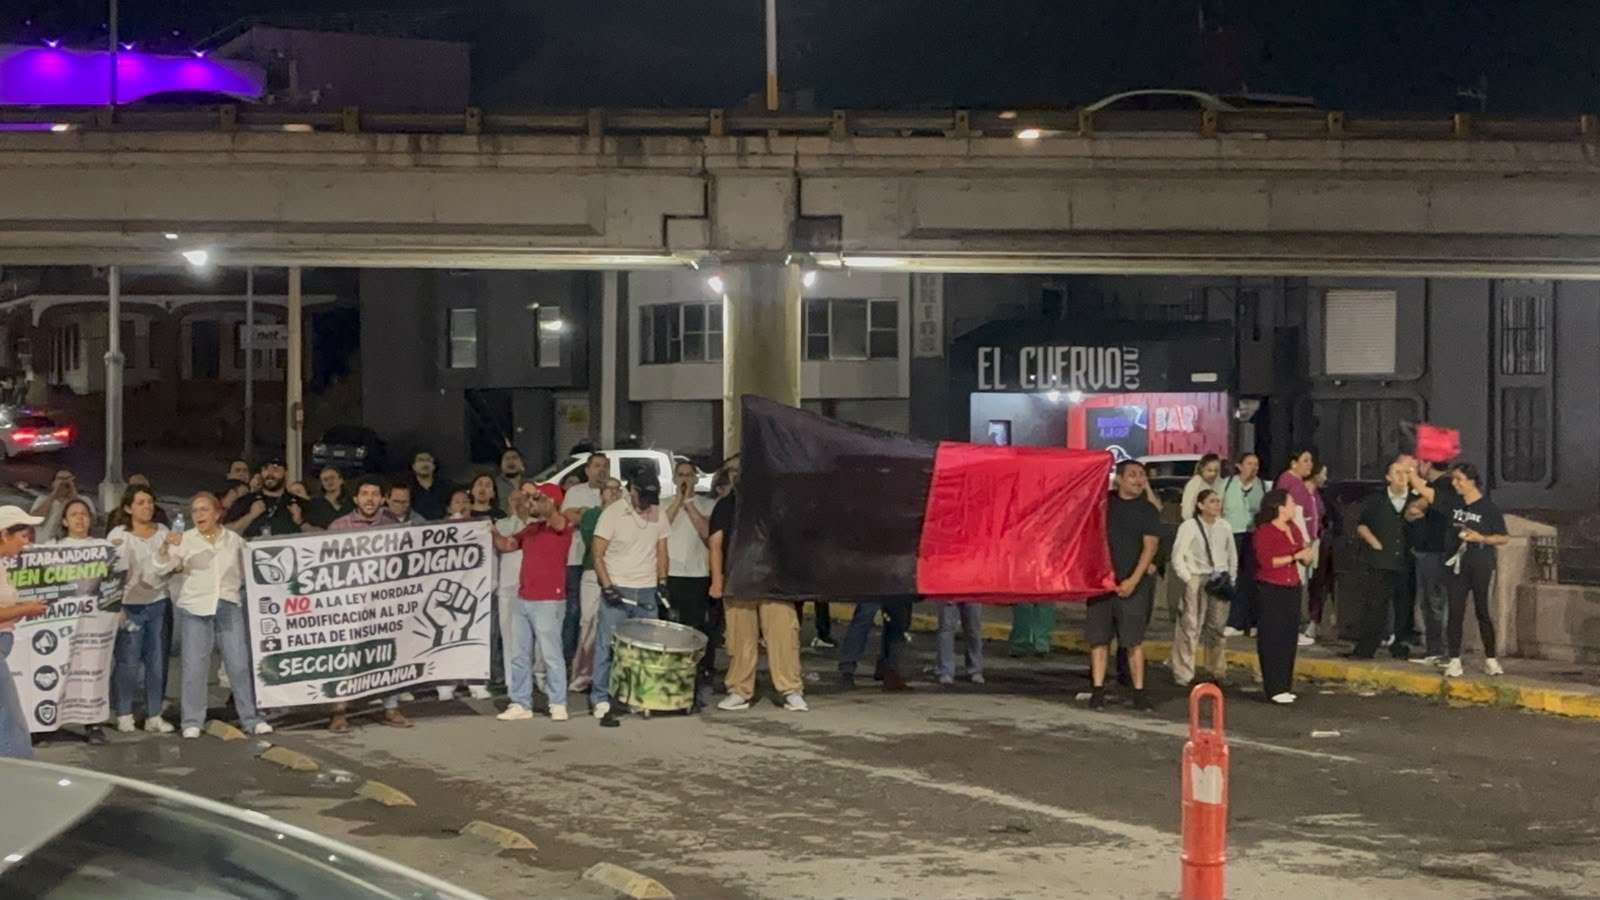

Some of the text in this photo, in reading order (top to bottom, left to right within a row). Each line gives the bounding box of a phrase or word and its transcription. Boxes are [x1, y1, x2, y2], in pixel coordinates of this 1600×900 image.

[977, 346, 1122, 390] EL CUERVO
[1155, 405, 1198, 432] BAR
[20, 546, 108, 570] TRABAJADORA
[319, 526, 458, 562] MARCHA POR
[43, 561, 108, 585] CUENTA
[297, 546, 480, 595] SALARIO DIGNO
[284, 583, 423, 614] NO A LA LEY MORDAZA
[380, 606, 394, 619] AL
[397, 601, 418, 616] RJP
[287, 619, 403, 647] FALTA DE INSUMOS
[278, 644, 392, 677] SECCIÓN VIII
[335, 664, 417, 696] CHIHUAHUA
